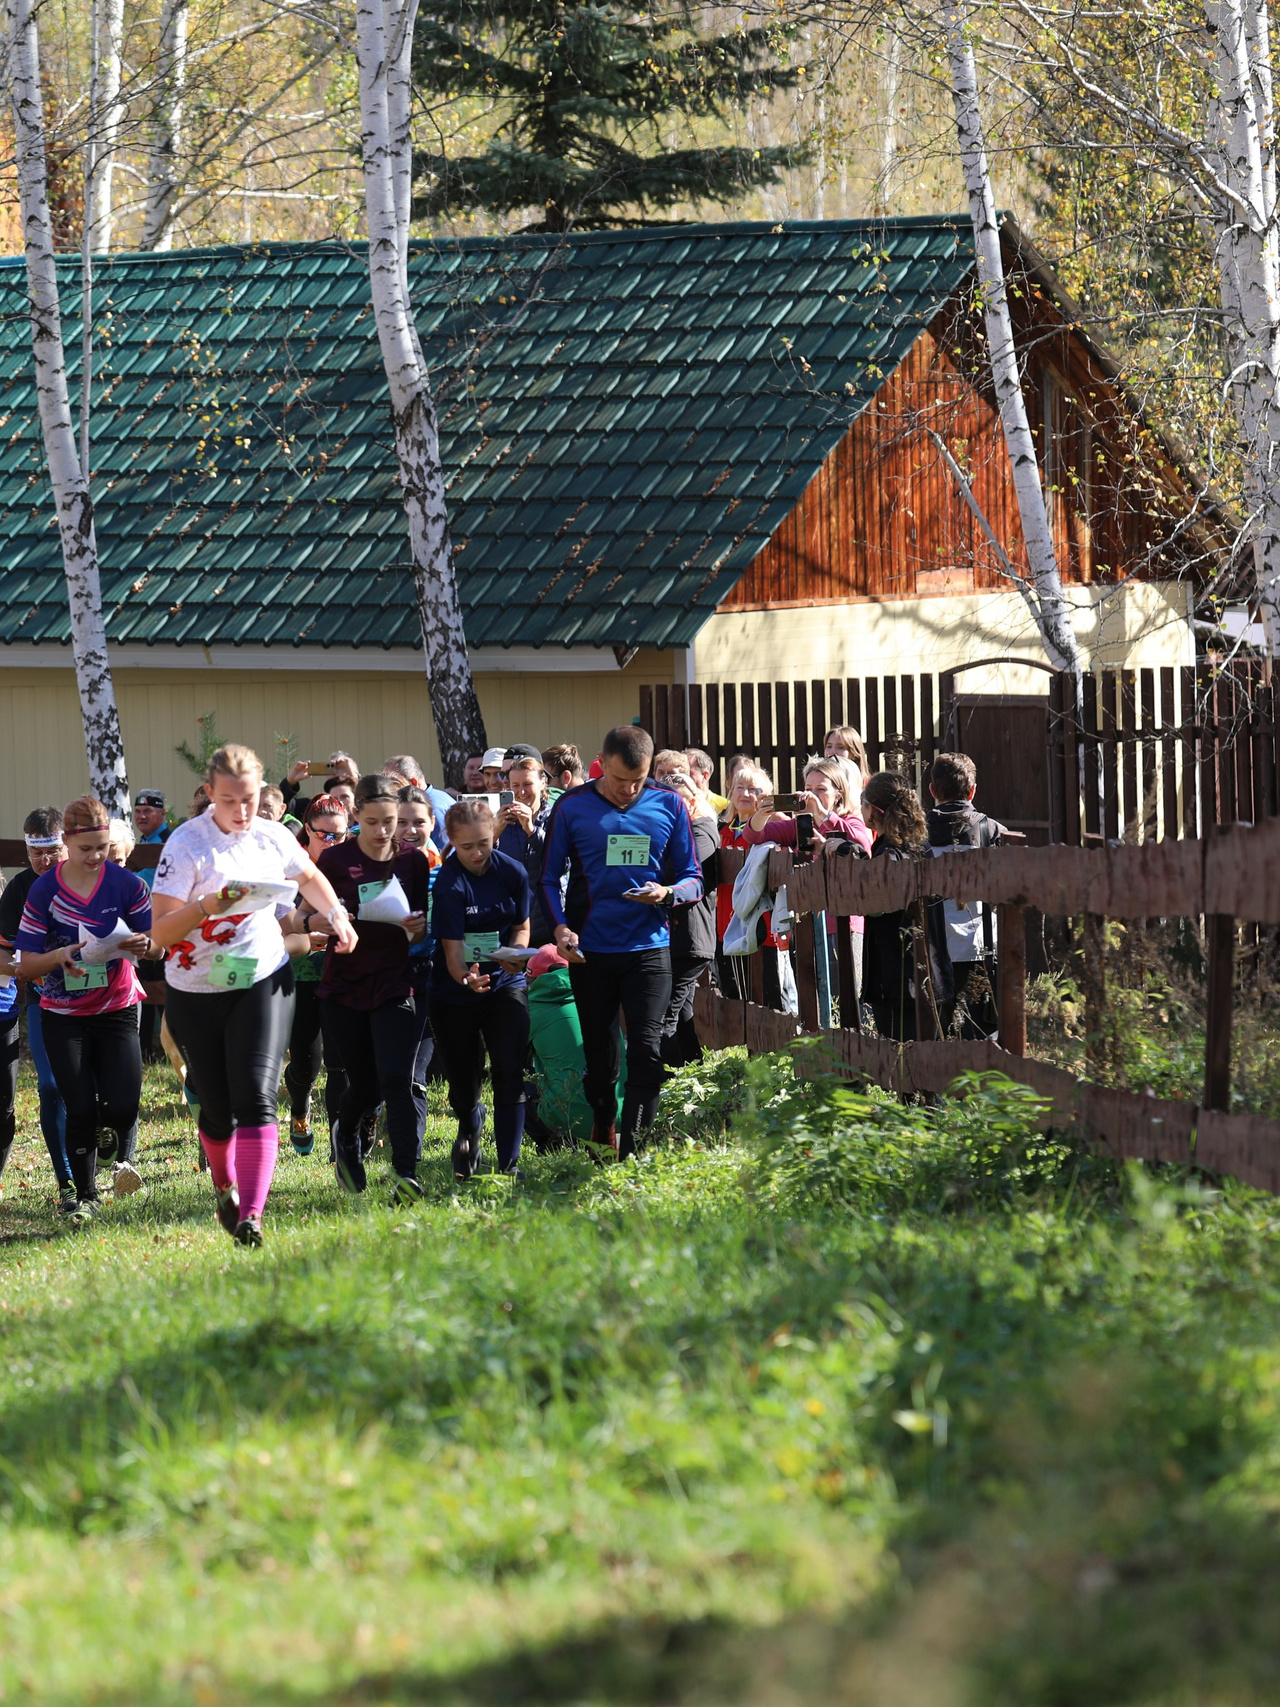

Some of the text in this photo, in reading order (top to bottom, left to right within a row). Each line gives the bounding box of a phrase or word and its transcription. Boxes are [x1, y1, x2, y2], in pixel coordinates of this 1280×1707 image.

[621, 849, 645, 864] 11 2
[82, 973, 105, 988] 7 1
[226, 971, 237, 986] 9
